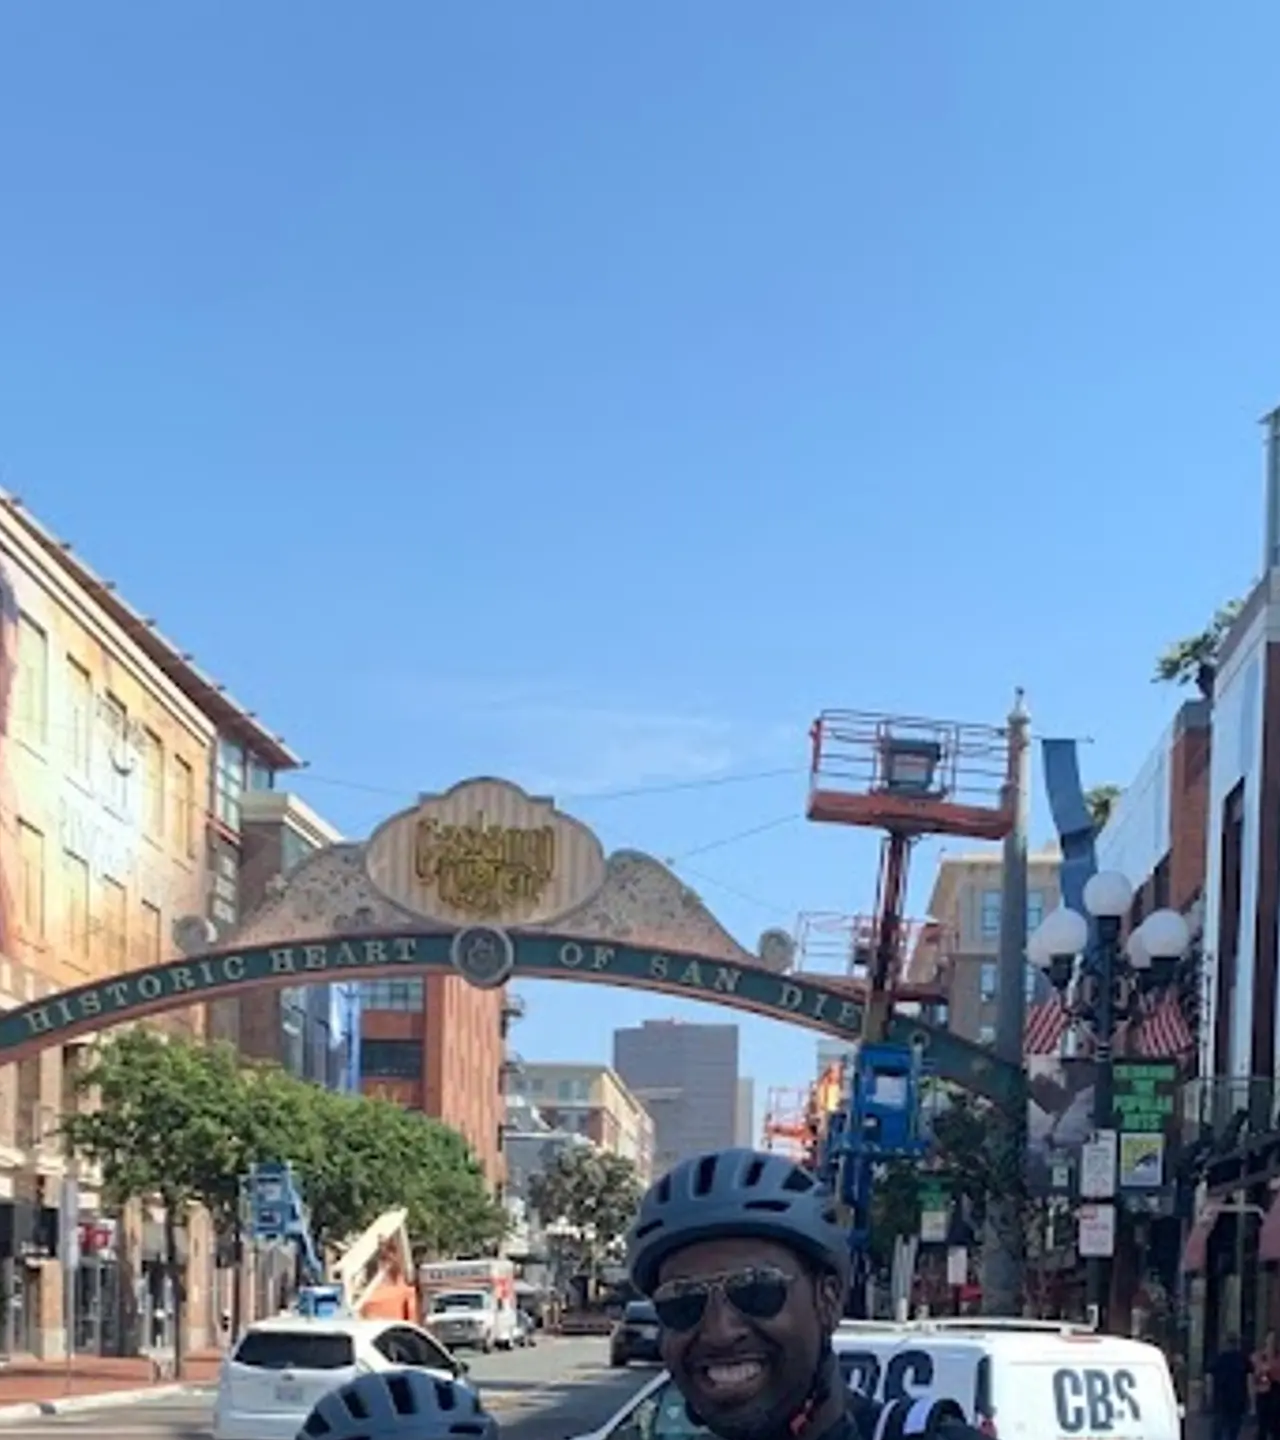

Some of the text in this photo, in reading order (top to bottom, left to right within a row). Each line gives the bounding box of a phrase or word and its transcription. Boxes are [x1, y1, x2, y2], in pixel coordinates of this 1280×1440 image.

[22, 954, 246, 1034] HISTORIC
[270, 936, 418, 975] HEART
[559, 941, 616, 970] OF
[649, 954, 743, 994] SAN
[1052, 1368, 1142, 1433] CBS
